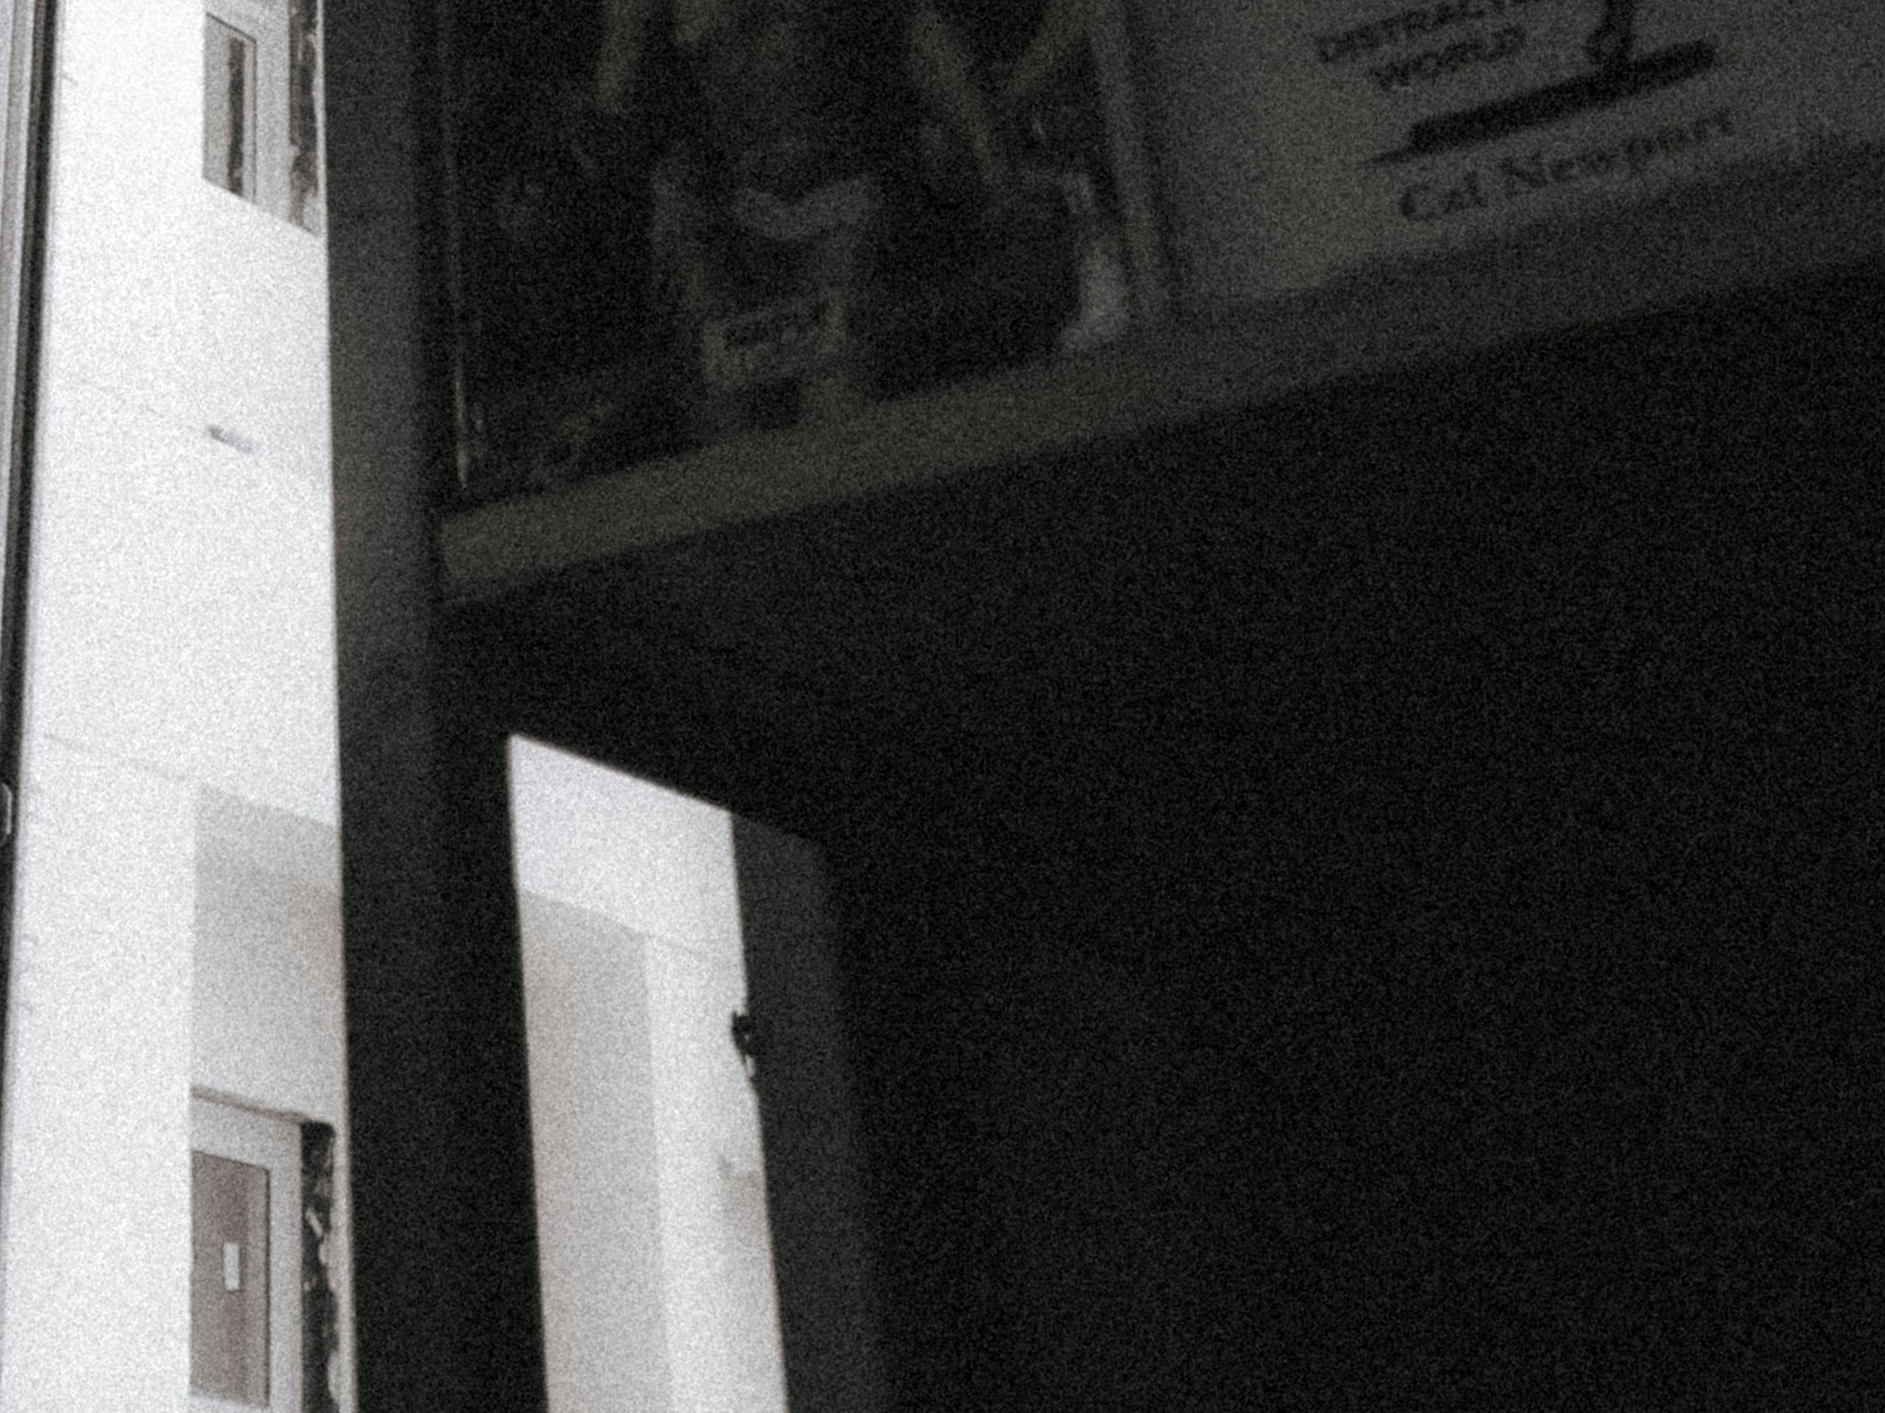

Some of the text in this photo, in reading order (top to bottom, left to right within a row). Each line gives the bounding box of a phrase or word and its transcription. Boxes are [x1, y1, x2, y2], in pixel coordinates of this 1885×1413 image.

[1368, 25, 1528, 93] WORLD
[1397, 107, 1737, 224] Cal Newport
